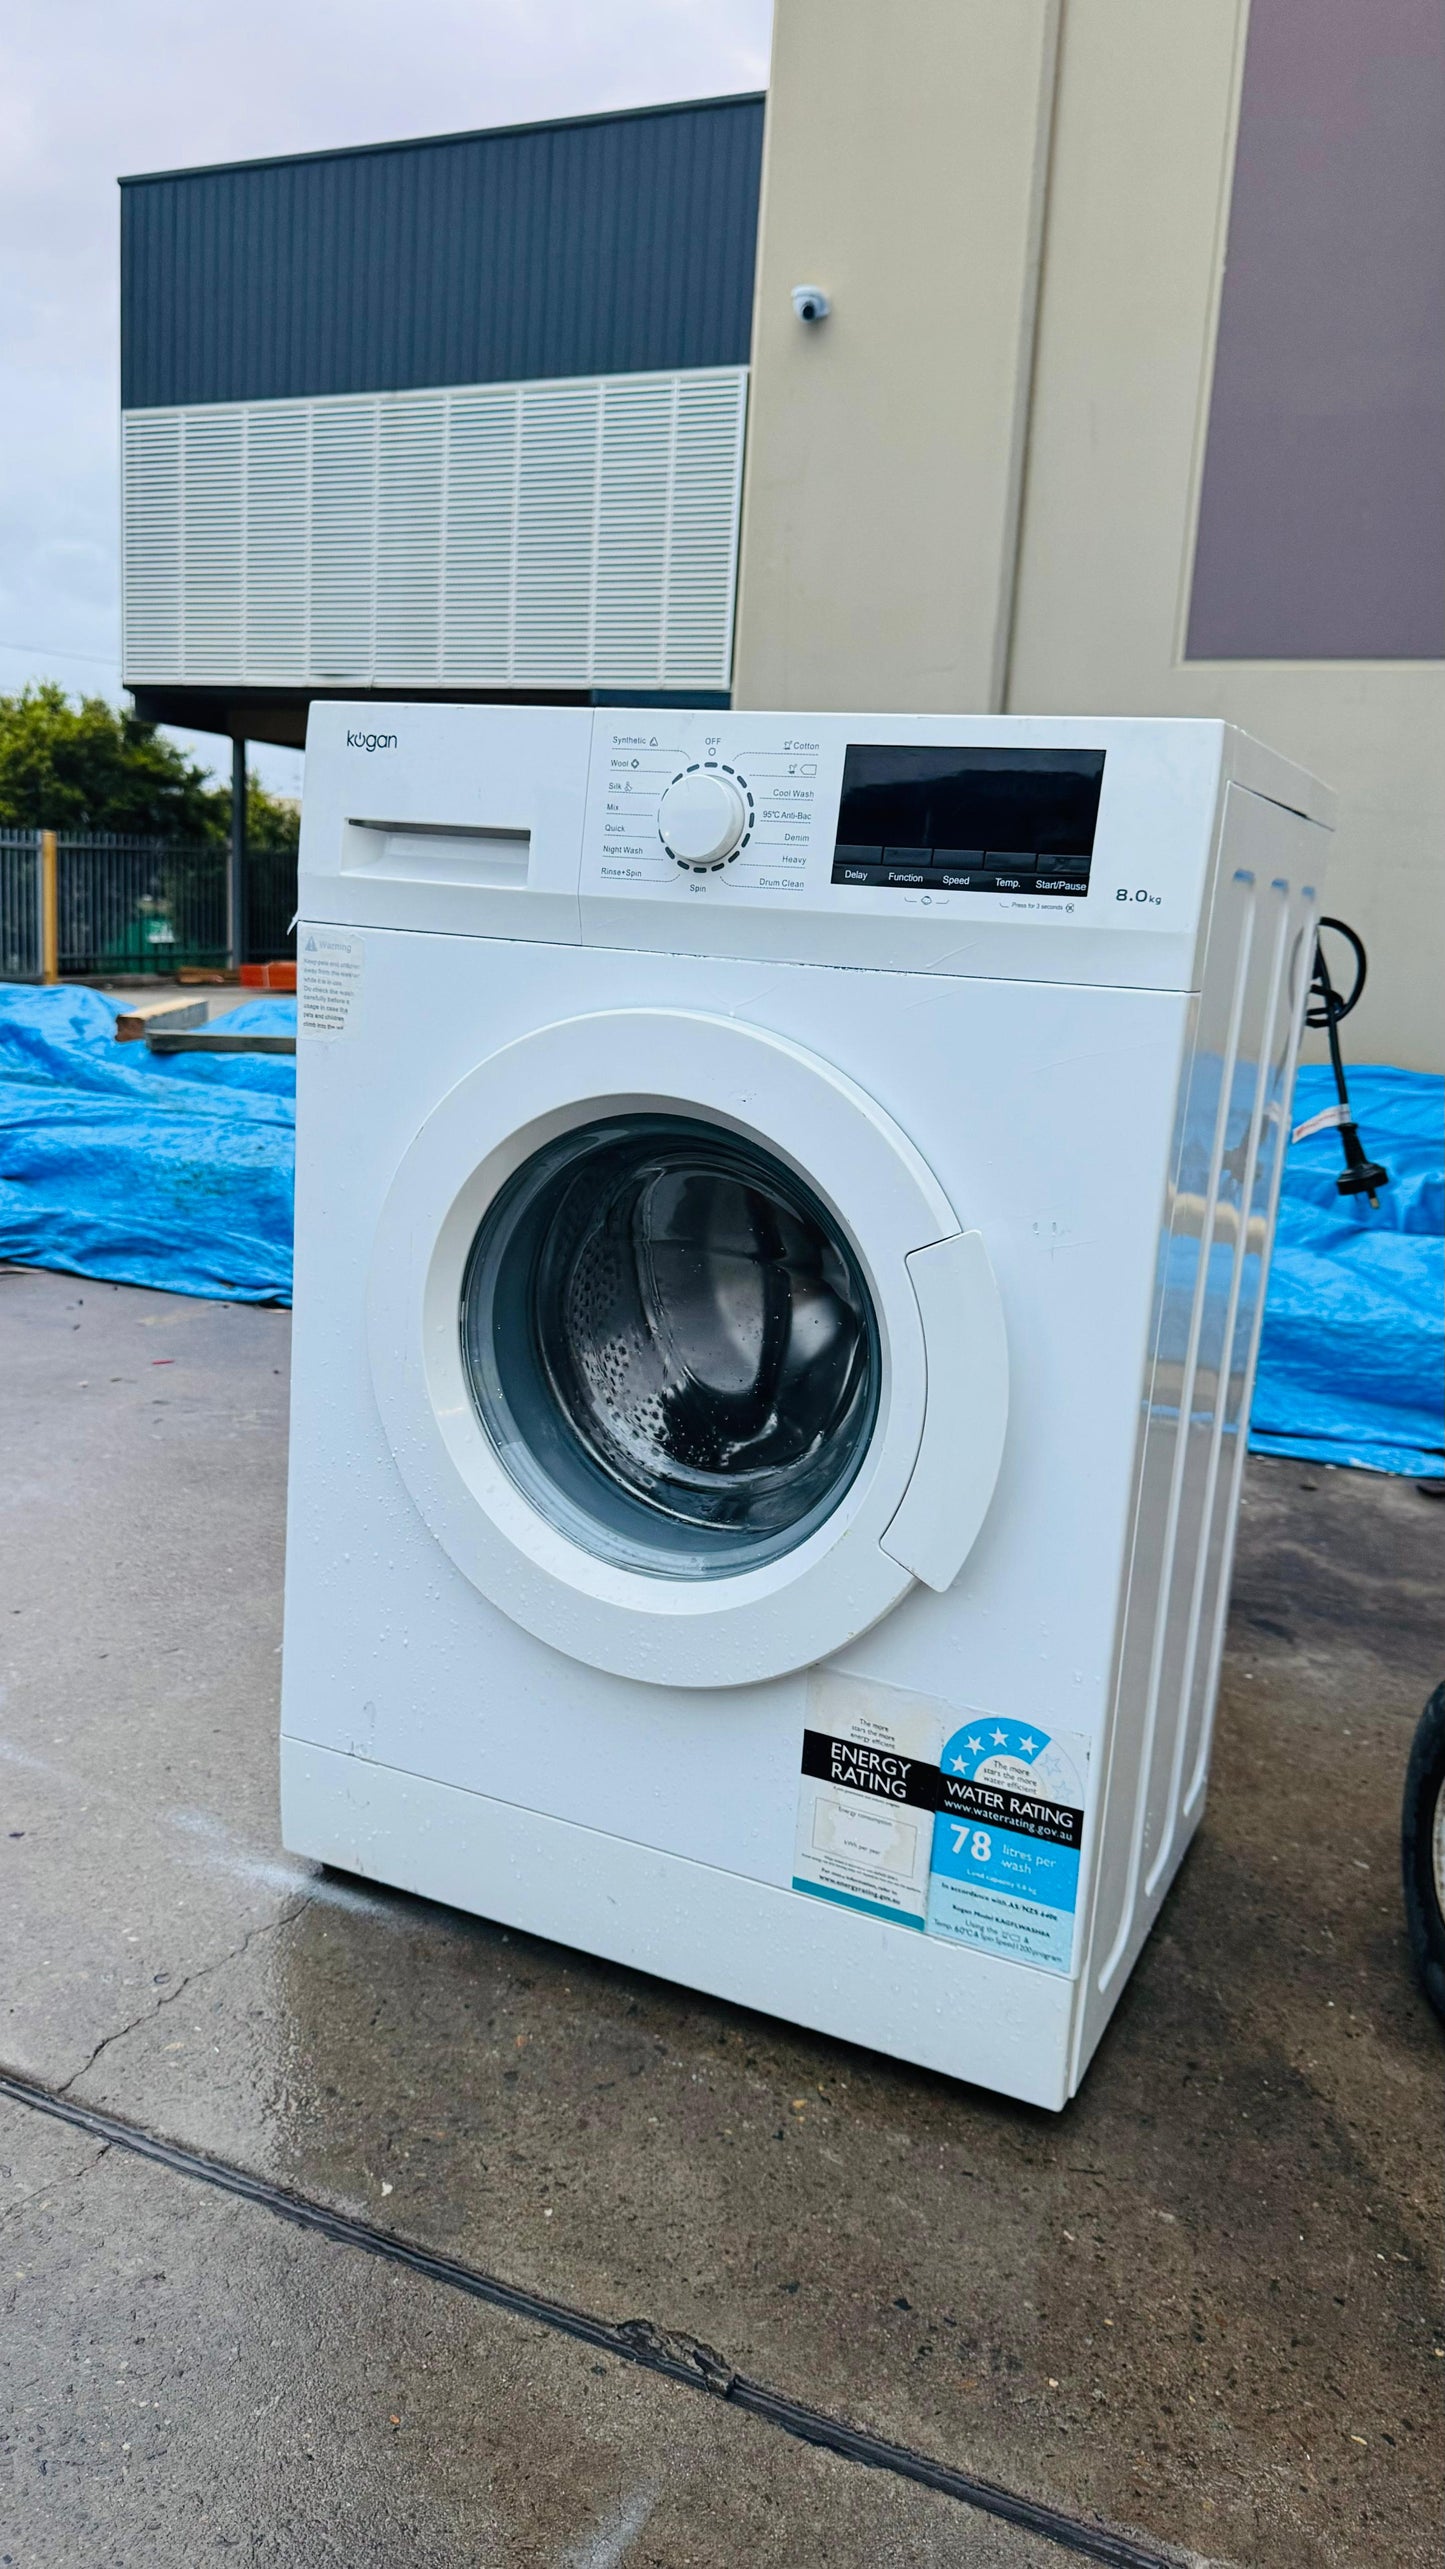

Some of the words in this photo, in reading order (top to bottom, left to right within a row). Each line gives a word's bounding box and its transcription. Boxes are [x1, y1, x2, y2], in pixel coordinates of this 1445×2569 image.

[347, 730, 397, 752] kogan
[612, 736, 646, 746] Synthetic
[705, 737, 721, 746] OFF
[794, 742, 820, 751] Cotton
[611, 759, 628, 768] Wool
[609, 782, 622, 790] Silk
[773, 789, 791, 798] Cool
[794, 790, 814, 799] Wash
[607, 803, 619, 812] Mix
[781, 811, 811, 820] Anti-Bac
[605, 824, 625, 834] Quick
[784, 833, 809, 842] Denim
[603, 846, 621, 857] Night
[623, 846, 643, 855] Wash
[782, 855, 806, 865] Heavy
[601, 868, 642, 878] Rinse+Spin
[760, 879, 781, 889] Drum
[783, 880, 804, 889] Clean
[845, 870, 868, 882] Delay
[889, 872, 923, 884] Function
[943, 875, 970, 887] Speed
[996, 878, 1021, 889] Temp.
[1036, 879, 1086, 892] Start/Pause
[690, 884, 706, 893] Spin
[320, 941, 351, 953] Warning
[860, 1719, 871, 1727] The
[873, 1724, 888, 1732] more
[831, 1742, 911, 1779] ENERGY
[994, 1760, 1006, 1769] The
[1010, 1767, 1030, 1776] more
[831, 1763, 907, 1799] RATING
[984, 1768, 1000, 1776] stars
[1003, 1772, 1015, 1780] the
[1017, 1777, 1037, 1786] more
[984, 1776, 1004, 1786] water
[1007, 1781, 1037, 1795] efficient
[947, 1780, 1004, 1810] WATER
[1010, 1798, 1073, 1828] RATING
[944, 1800, 1073, 1841] www.waterrating.gov.au
[950, 1823, 992, 1862] 78
[1003, 1844, 1032, 1862] litres
[1036, 1856, 1056, 1867] per
[1001, 1860, 1032, 1874] wash
